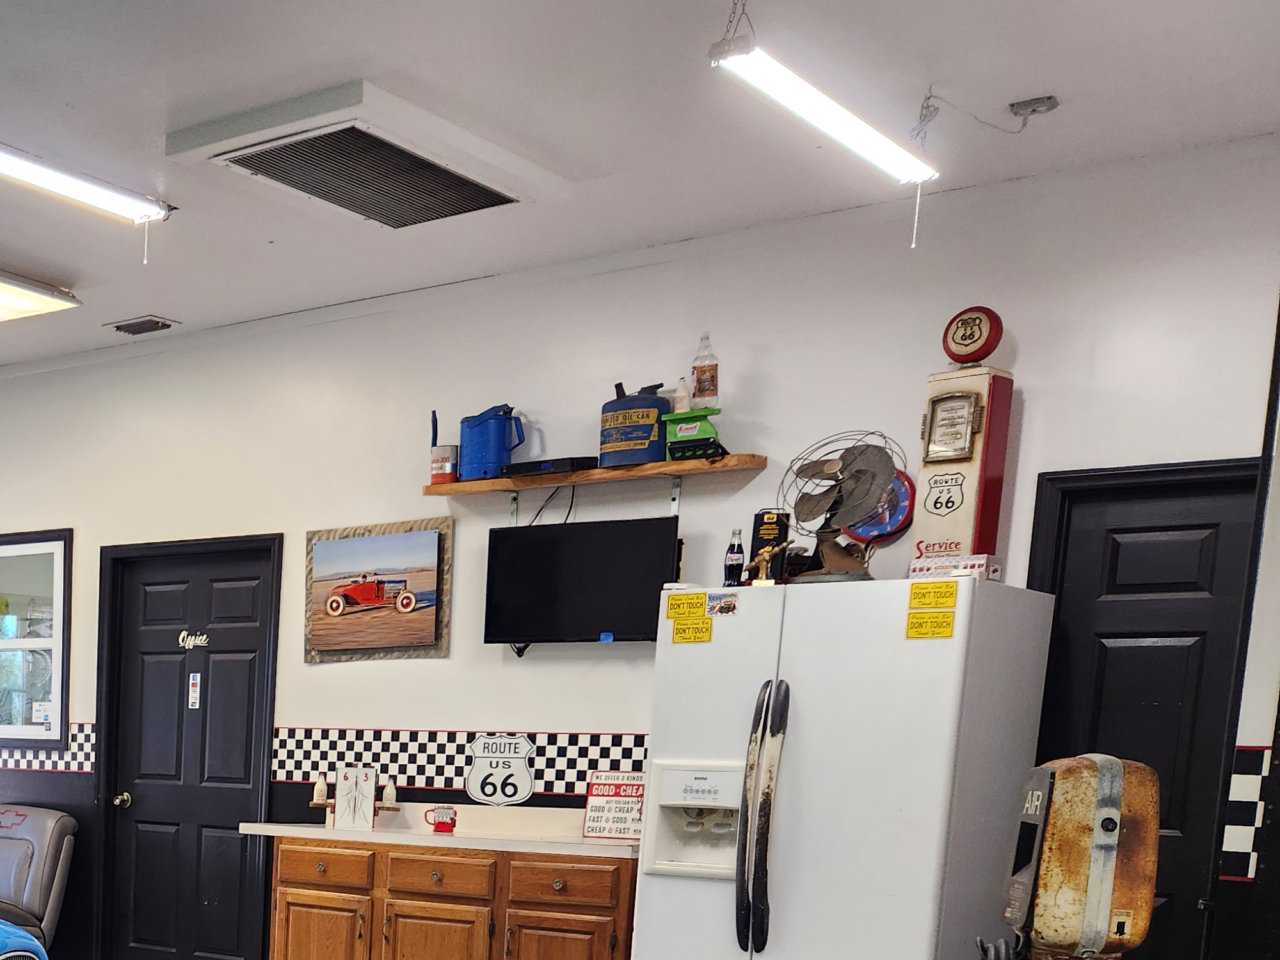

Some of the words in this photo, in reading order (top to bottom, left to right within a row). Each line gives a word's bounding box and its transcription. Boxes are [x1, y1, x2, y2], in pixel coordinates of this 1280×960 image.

[961, 331, 975, 341] 66
[933, 477, 959, 485] ROUTE
[934, 495, 955, 510] 66
[915, 539, 961, 559] Service
[913, 591, 931, 600] DON'T
[933, 590, 954, 599] TOUCH
[670, 602, 685, 610] DON'T
[687, 601, 703, 609] TOUCH
[910, 621, 928, 629] DON'T
[930, 621, 950, 629] TOUCH
[676, 627, 690, 635] DON'T
[692, 626, 709, 634] TOUCH
[179, 630, 209, 650] Office
[483, 742, 520, 754] ROUTE
[490, 761, 511, 769] US
[343, 772, 348, 781] 6
[363, 773, 368, 781] 3
[480, 773, 518, 798] 66
[592, 785, 615, 795] GOOD
[620, 786, 644, 796] CHEA
[1023, 791, 1043, 815] AIR
